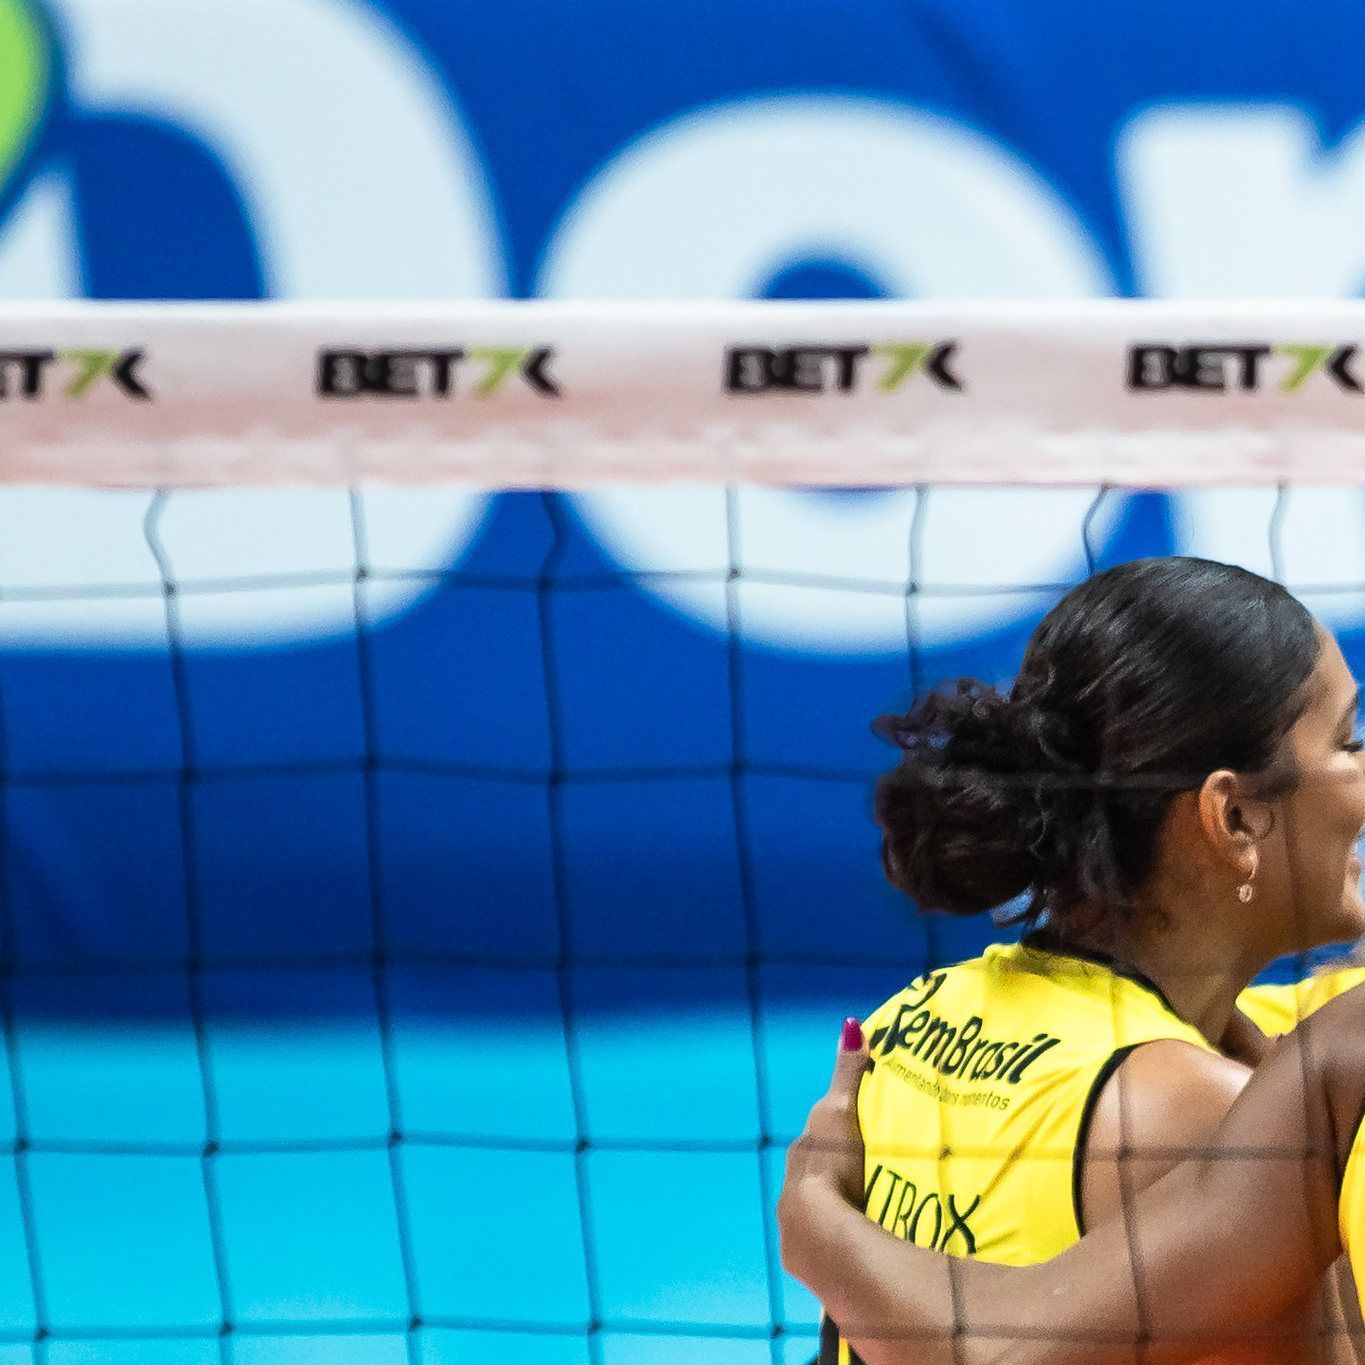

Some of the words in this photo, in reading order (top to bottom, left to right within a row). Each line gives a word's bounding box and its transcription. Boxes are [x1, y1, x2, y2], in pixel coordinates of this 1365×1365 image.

[0, 349, 152, 402] T7K
[315, 347, 560, 400] BET7K
[722, 342, 963, 396] BET7K
[1126, 341, 1363, 393] BET7K
